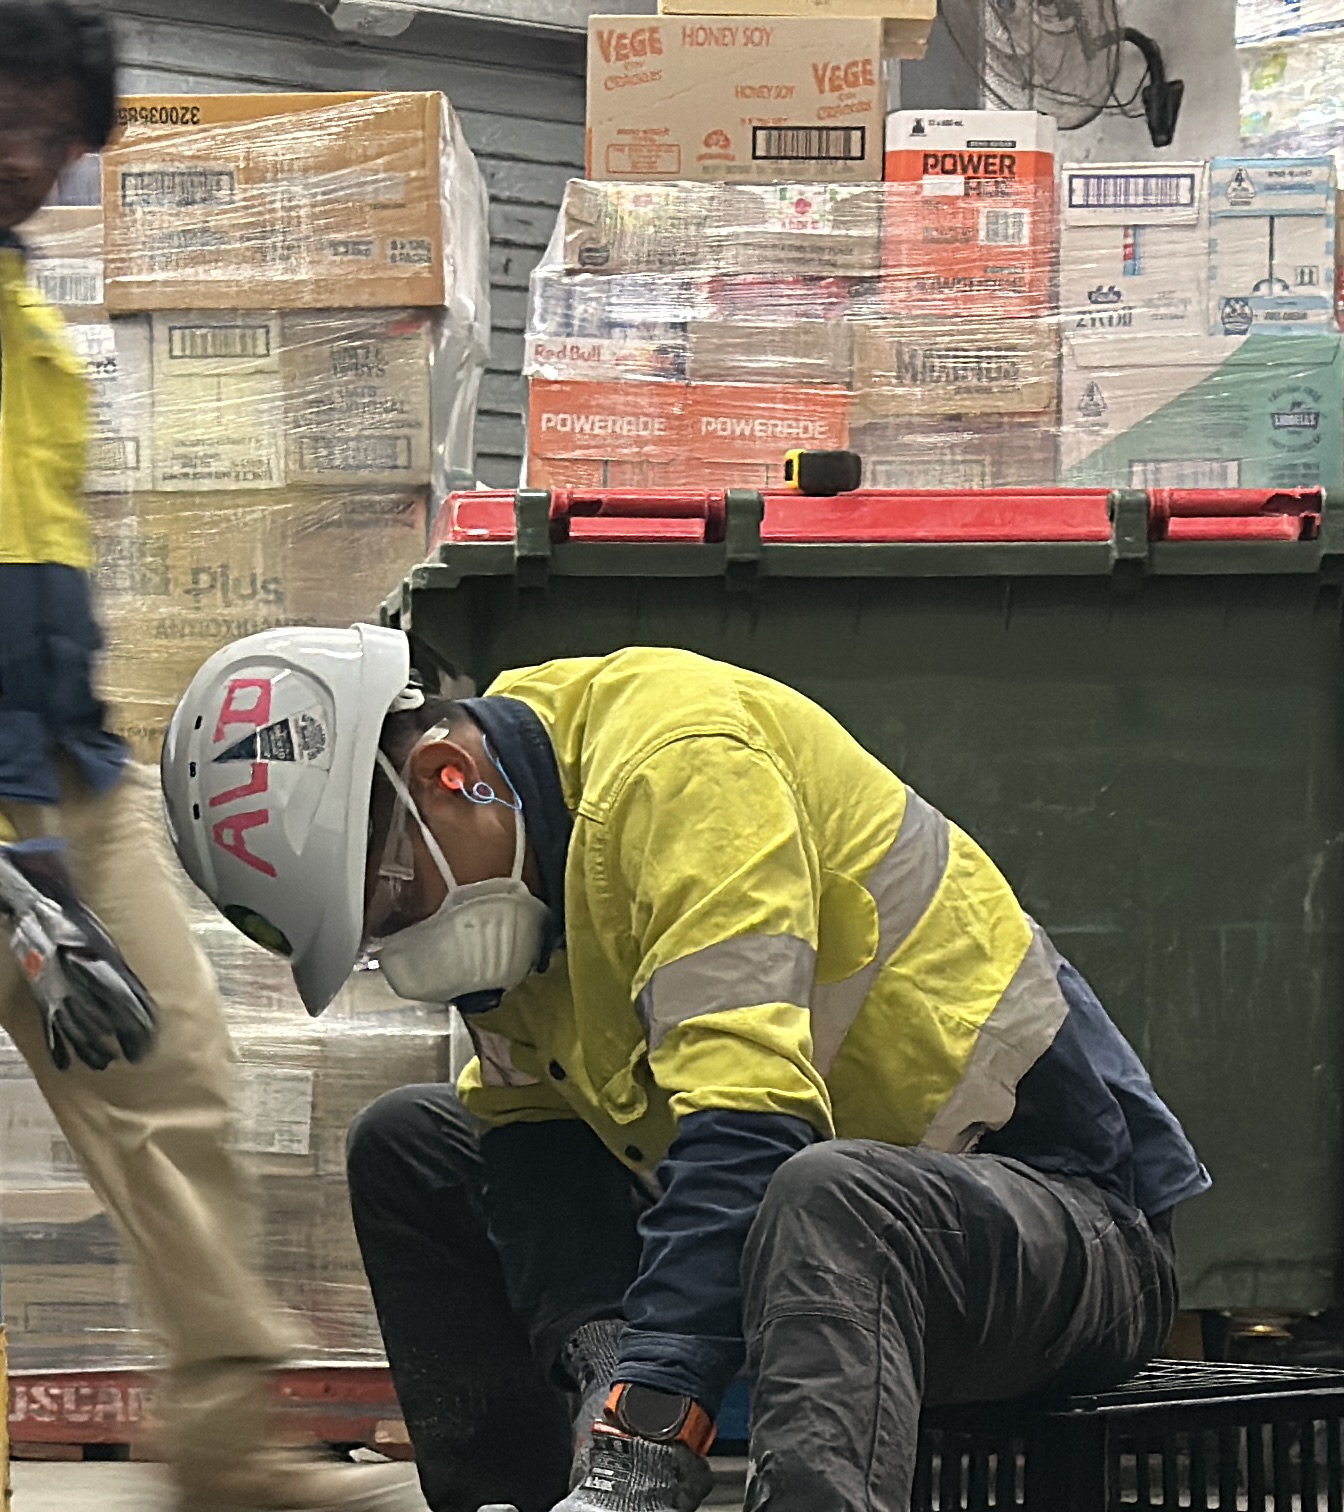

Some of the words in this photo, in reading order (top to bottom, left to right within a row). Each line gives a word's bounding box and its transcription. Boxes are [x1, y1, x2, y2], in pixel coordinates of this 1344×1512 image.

[596, 27, 663, 62] VEGE
[682, 26, 738, 47] HONEY
[743, 27, 774, 47] SOY
[812, 59, 875, 95] VEGE
[923, 153, 1016, 175] POWER
[535, 344, 567, 361] Red
[570, 344, 601, 362] Bull
[541, 413, 667, 437] POWERADE
[700, 416, 830, 438] POWERADE
